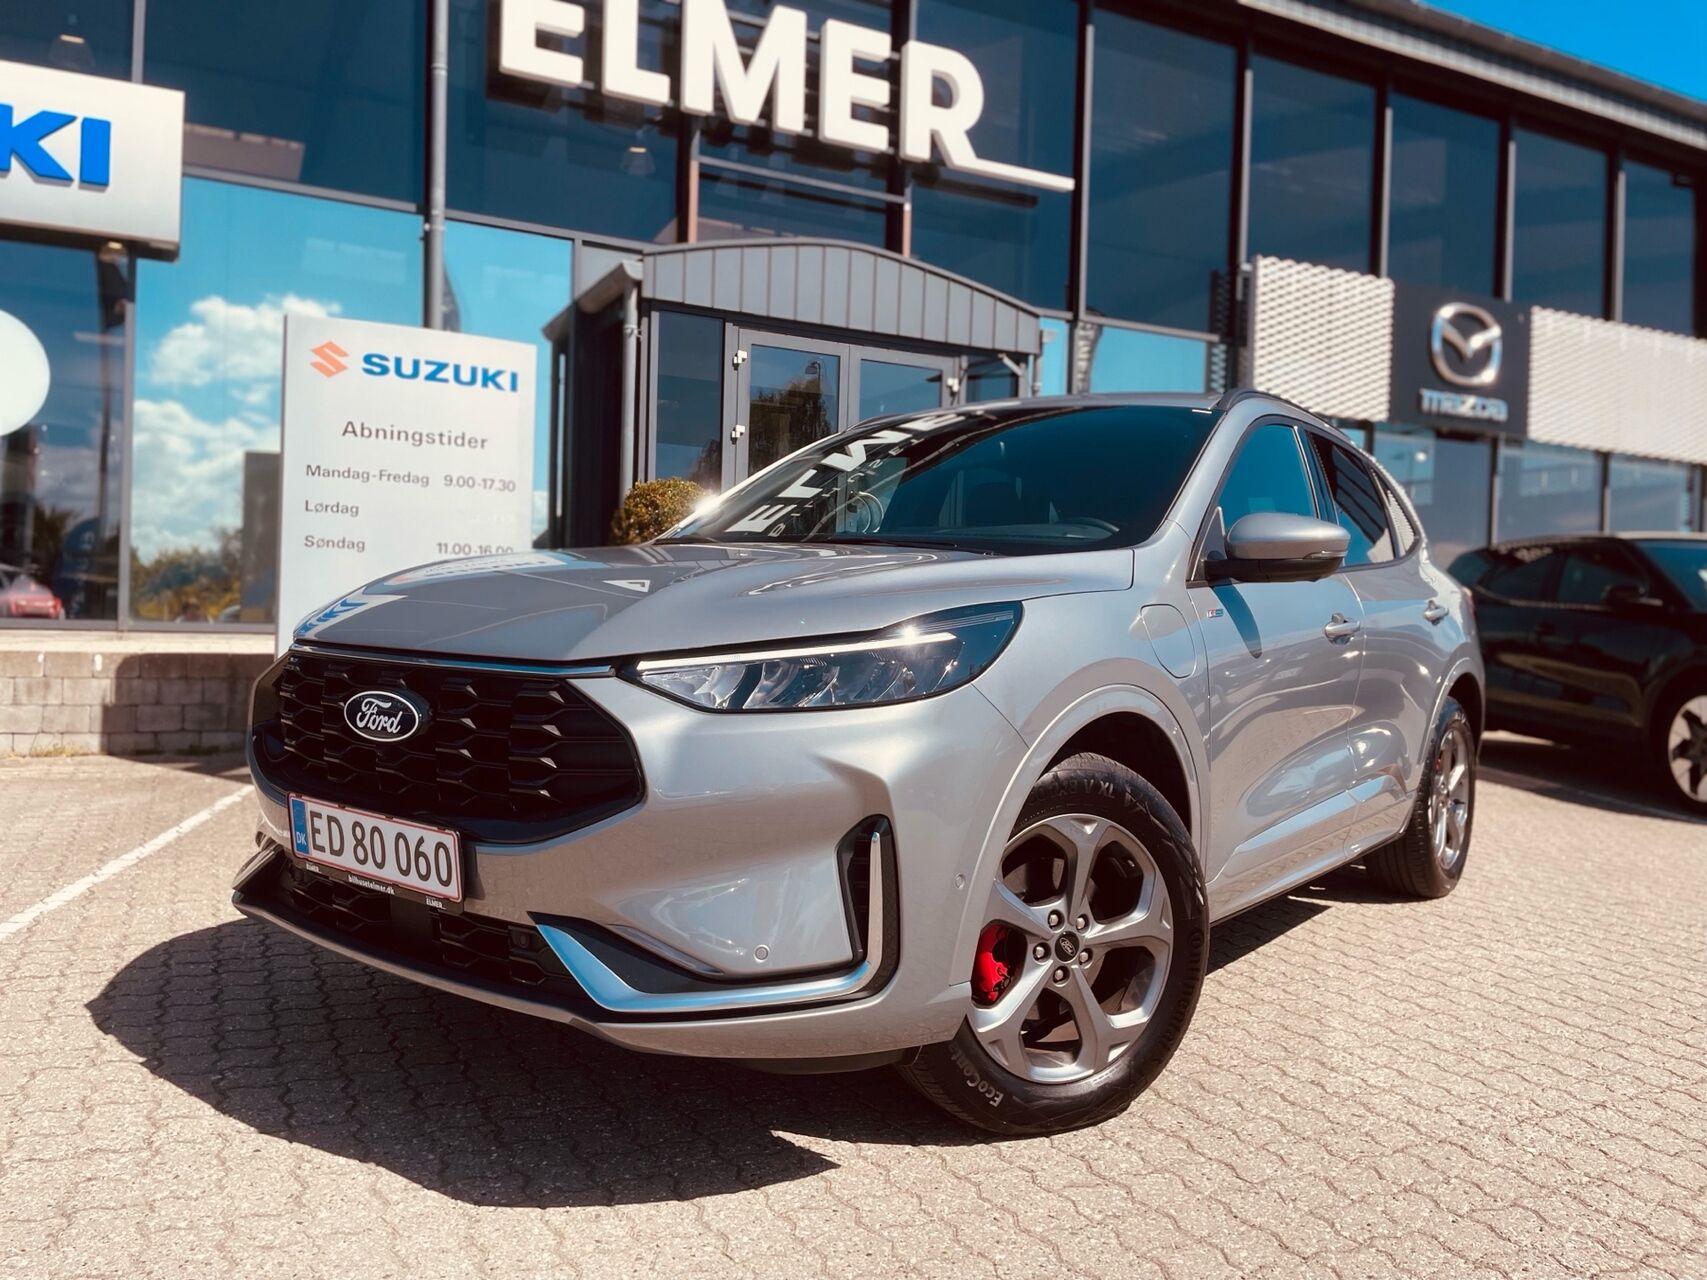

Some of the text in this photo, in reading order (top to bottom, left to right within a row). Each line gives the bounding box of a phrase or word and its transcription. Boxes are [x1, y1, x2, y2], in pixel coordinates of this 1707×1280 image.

[500, 0, 1075, 191] ELMER
[362, 353, 519, 393] SUZUKI
[443, 475, 516, 492] 9.00-17.30
[304, 499, 360, 517] Lørdag
[304, 534, 514, 556] Søndag 11.00-1600
[356, 698, 403, 734] Ford
[296, 831, 308, 846] DK
[309, 810, 453, 888] ED 80 060
